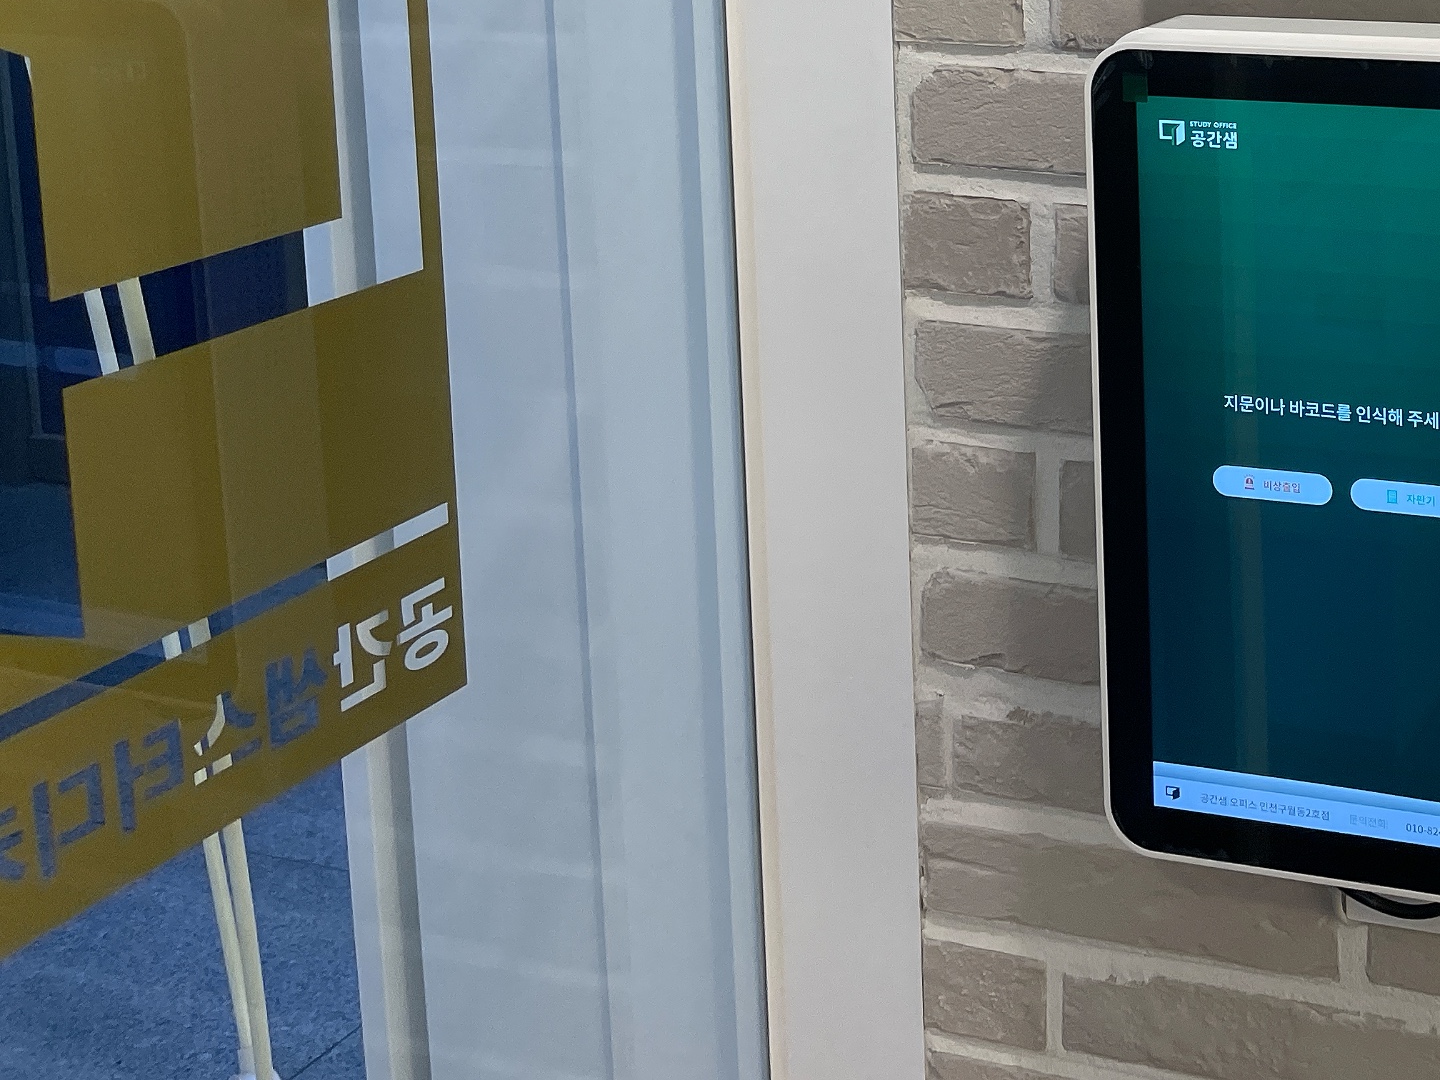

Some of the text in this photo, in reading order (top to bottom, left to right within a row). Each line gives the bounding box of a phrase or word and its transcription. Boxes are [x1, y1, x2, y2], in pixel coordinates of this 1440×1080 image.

[1191, 131, 1238, 149] 공간샘
[1224, 395, 1285, 415] 지문이나
[1290, 400, 1351, 421] 바코드를
[1356, 406, 1402, 426] 인식해
[1200, 793, 1227, 806] 공간샘
[1230, 797, 1257, 810] 오피스
